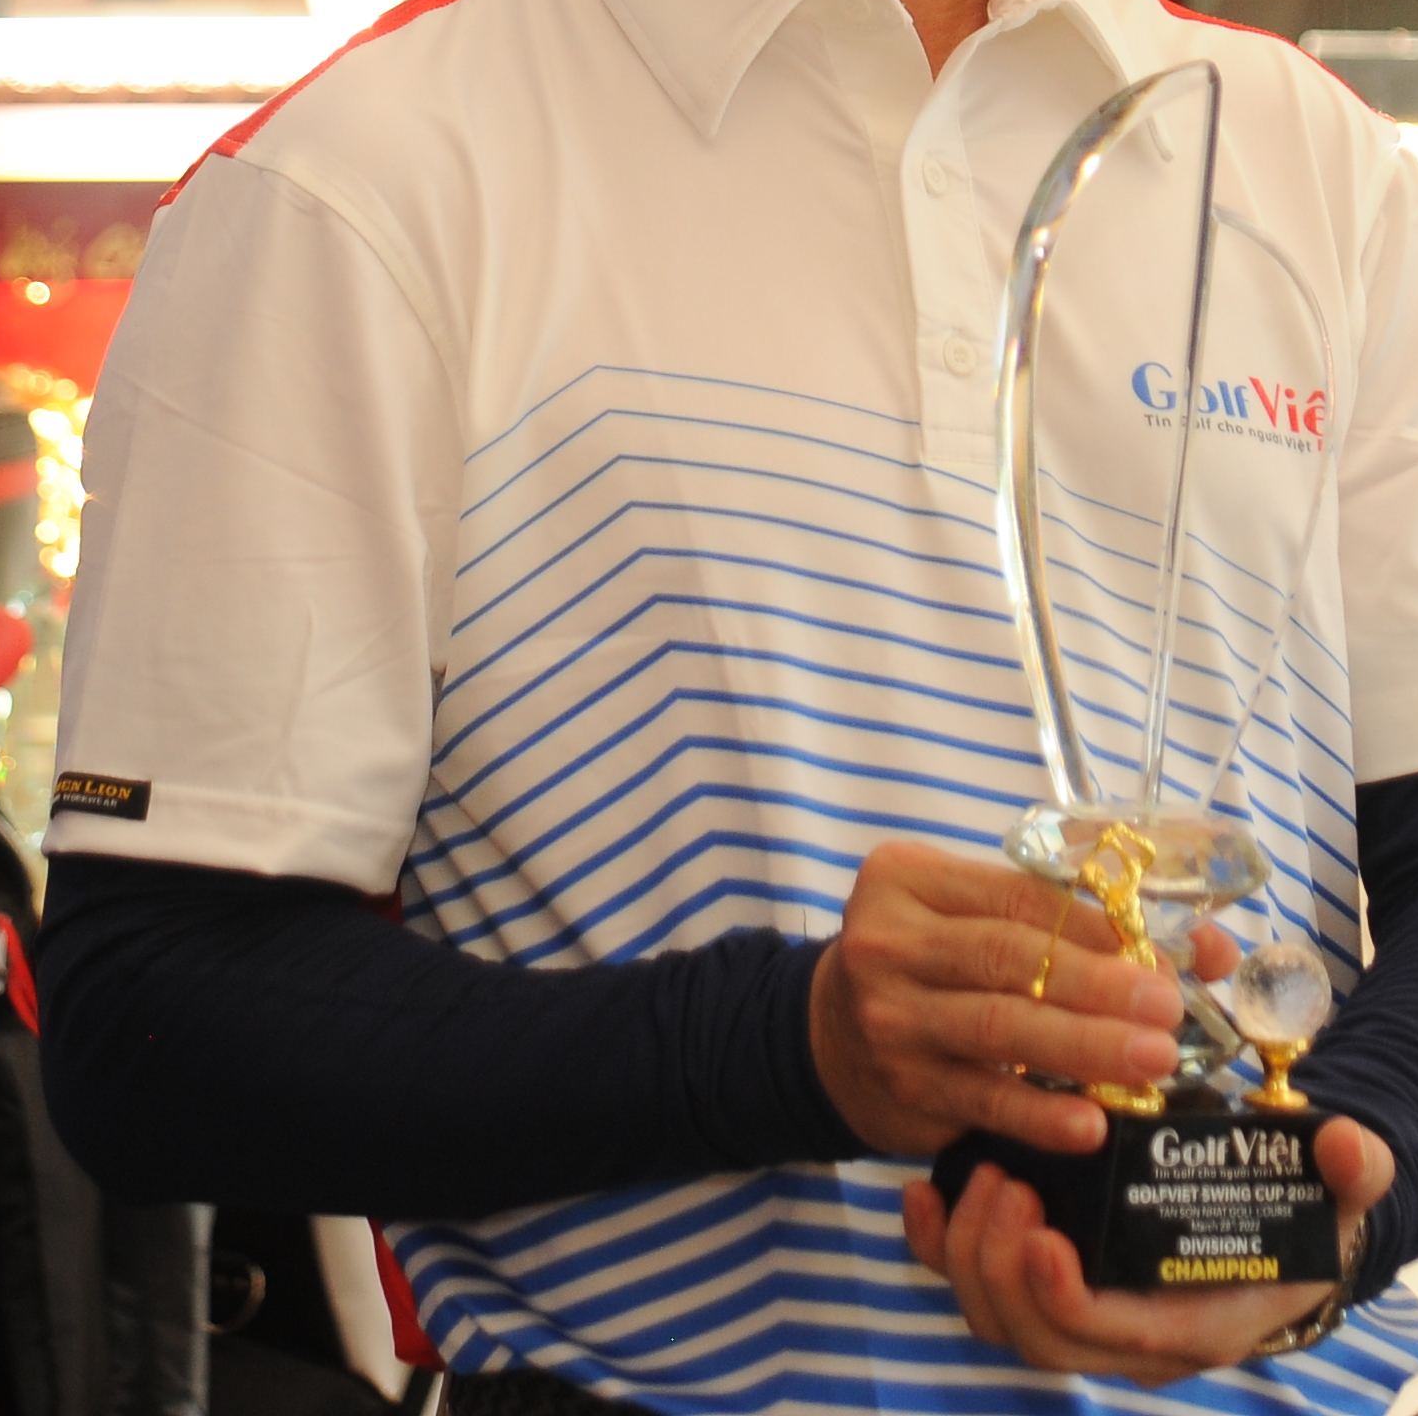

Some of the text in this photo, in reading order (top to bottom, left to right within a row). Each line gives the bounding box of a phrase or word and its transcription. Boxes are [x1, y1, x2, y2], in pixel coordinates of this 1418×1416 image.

[1143, 413, 1172, 428] Tin
[1217, 420, 1244, 435] cho
[1284, 435, 1312, 453] Việt
[85, 780, 132, 800] LION
[1128, 1184, 1199, 1204] GOLFVIET
[1202, 1184, 1252, 1202] SWING
[1255, 1183, 1284, 1202] CUP
[1179, 1236, 1262, 1256] DIVISION C
[1160, 1256, 1279, 1282] CHAMPION
